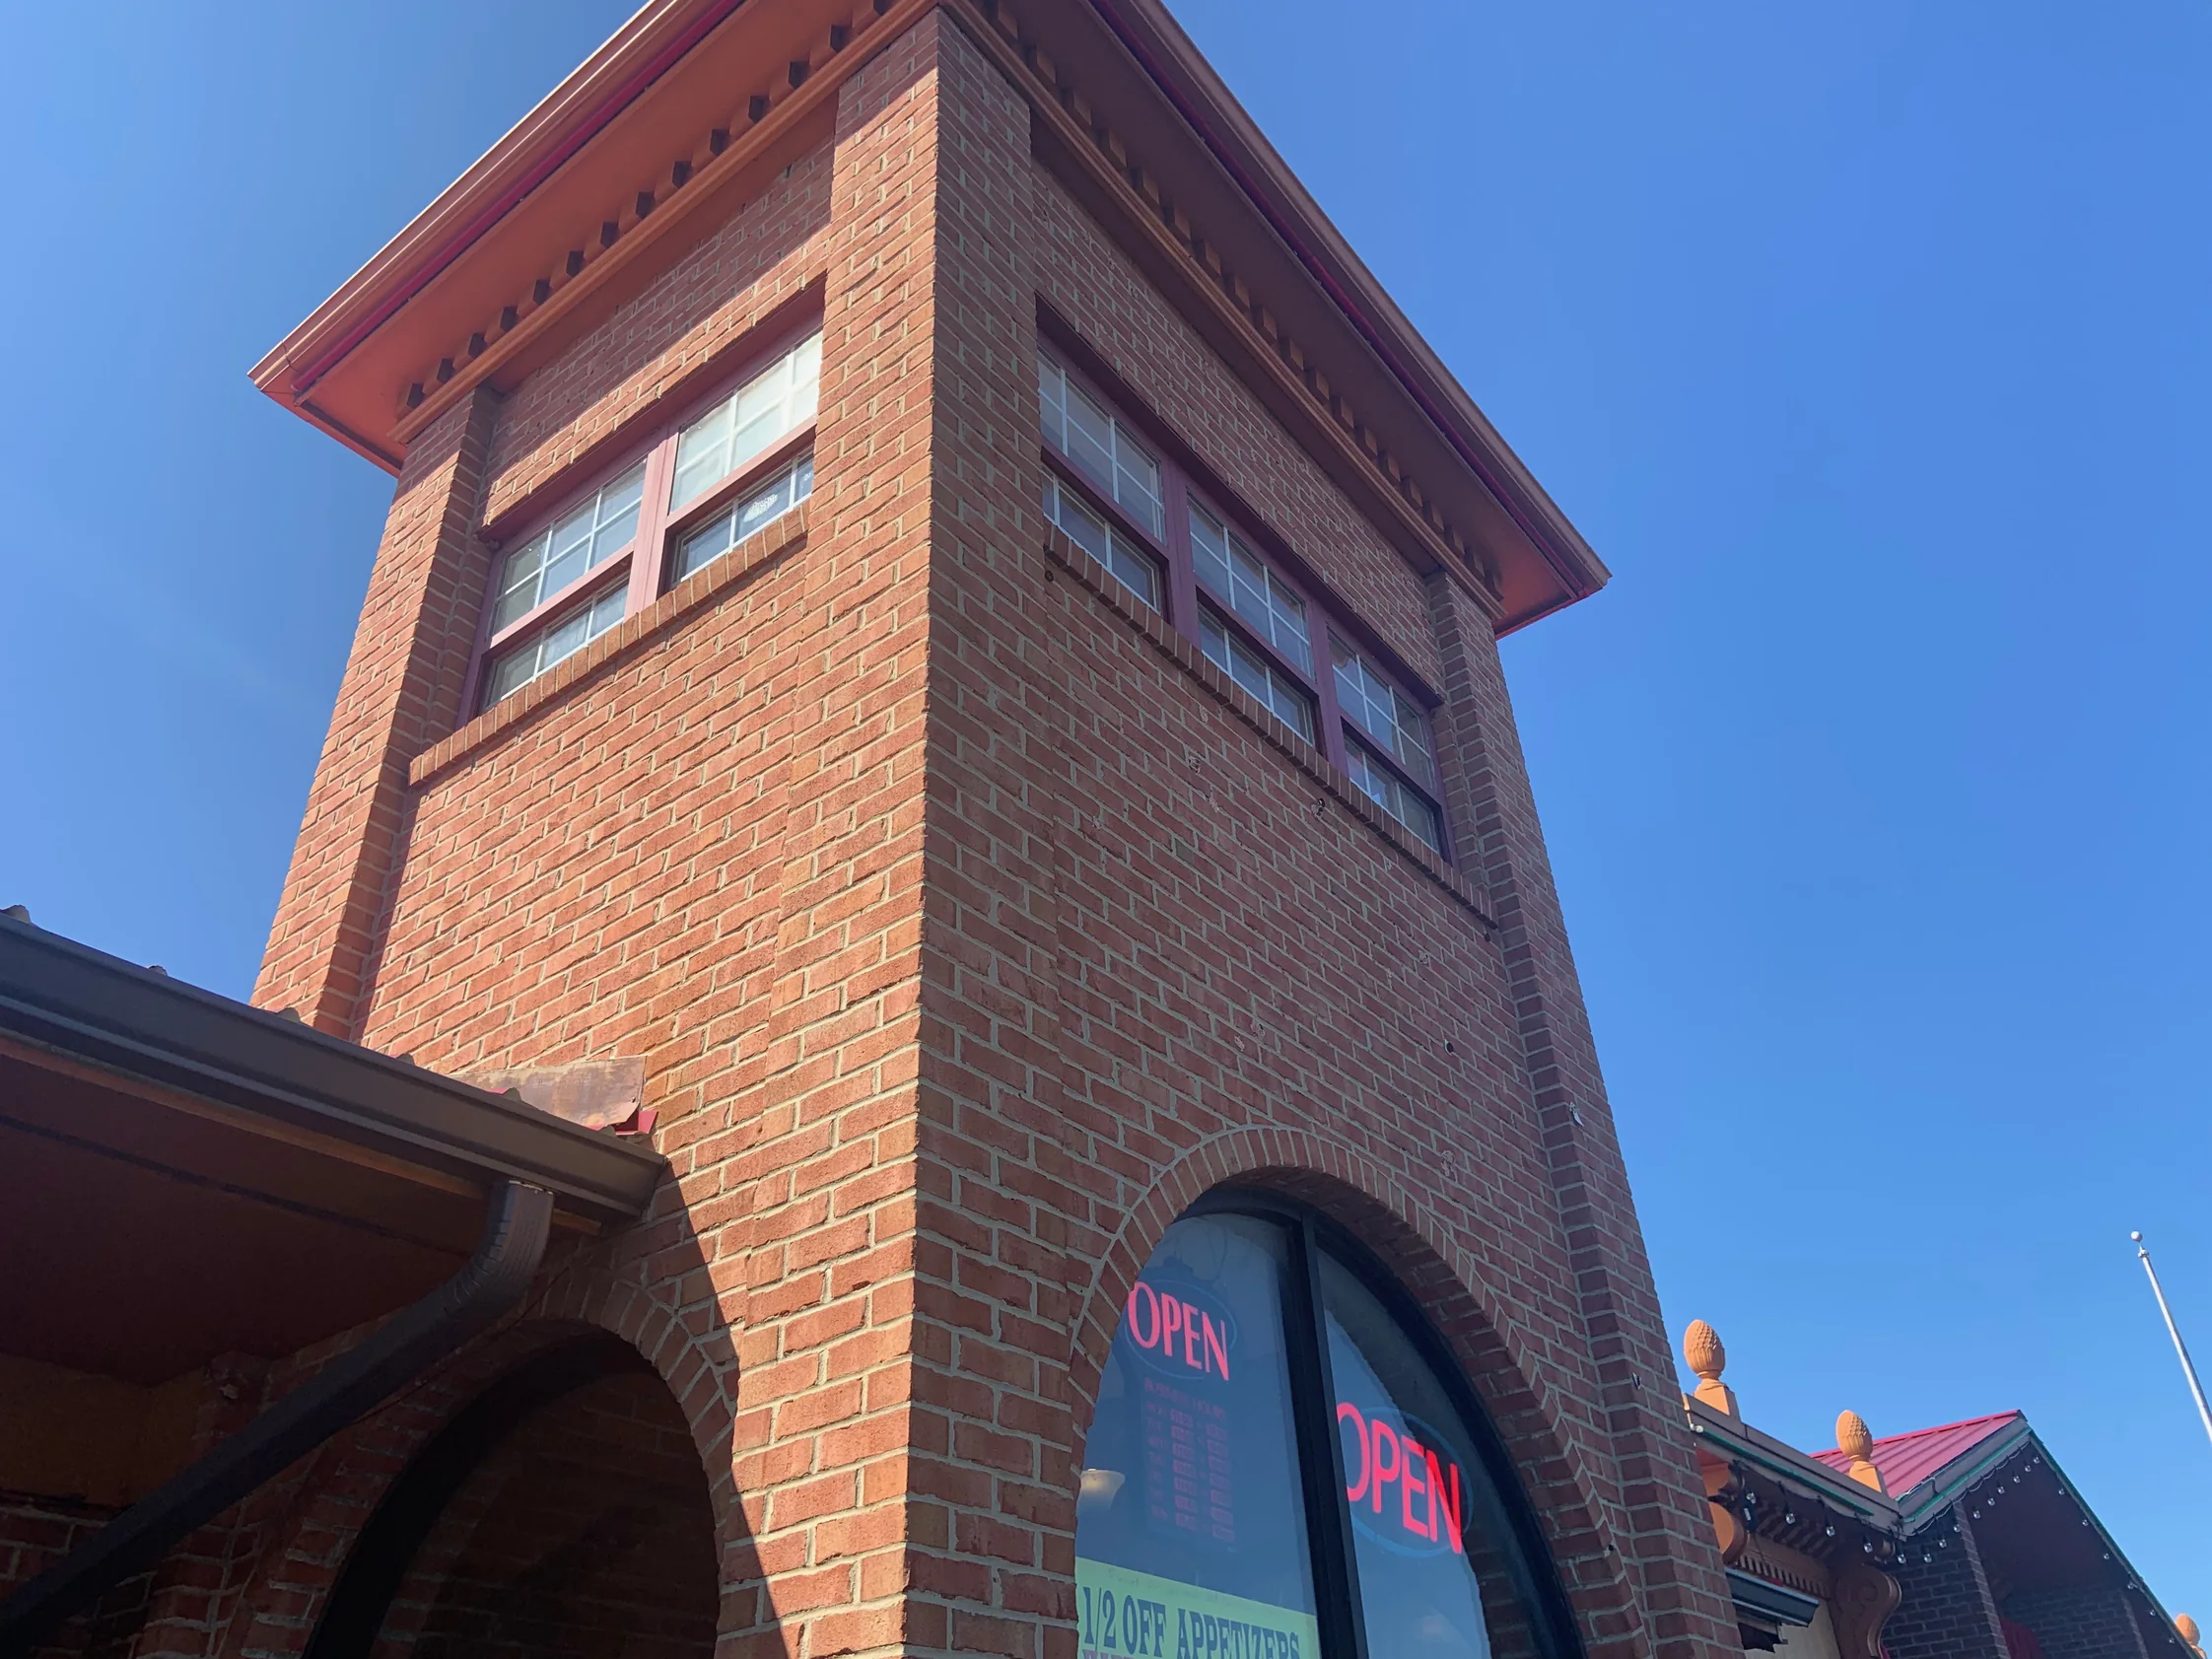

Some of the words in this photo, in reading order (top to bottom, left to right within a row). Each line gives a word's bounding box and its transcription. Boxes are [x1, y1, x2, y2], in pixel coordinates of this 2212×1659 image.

[1127, 1281, 1229, 1381] OPEN
[1336, 1402, 1462, 1555] OPEN
[1082, 1586, 1117, 1652] 1/2
[1123, 1594, 1167, 1658] OFF
